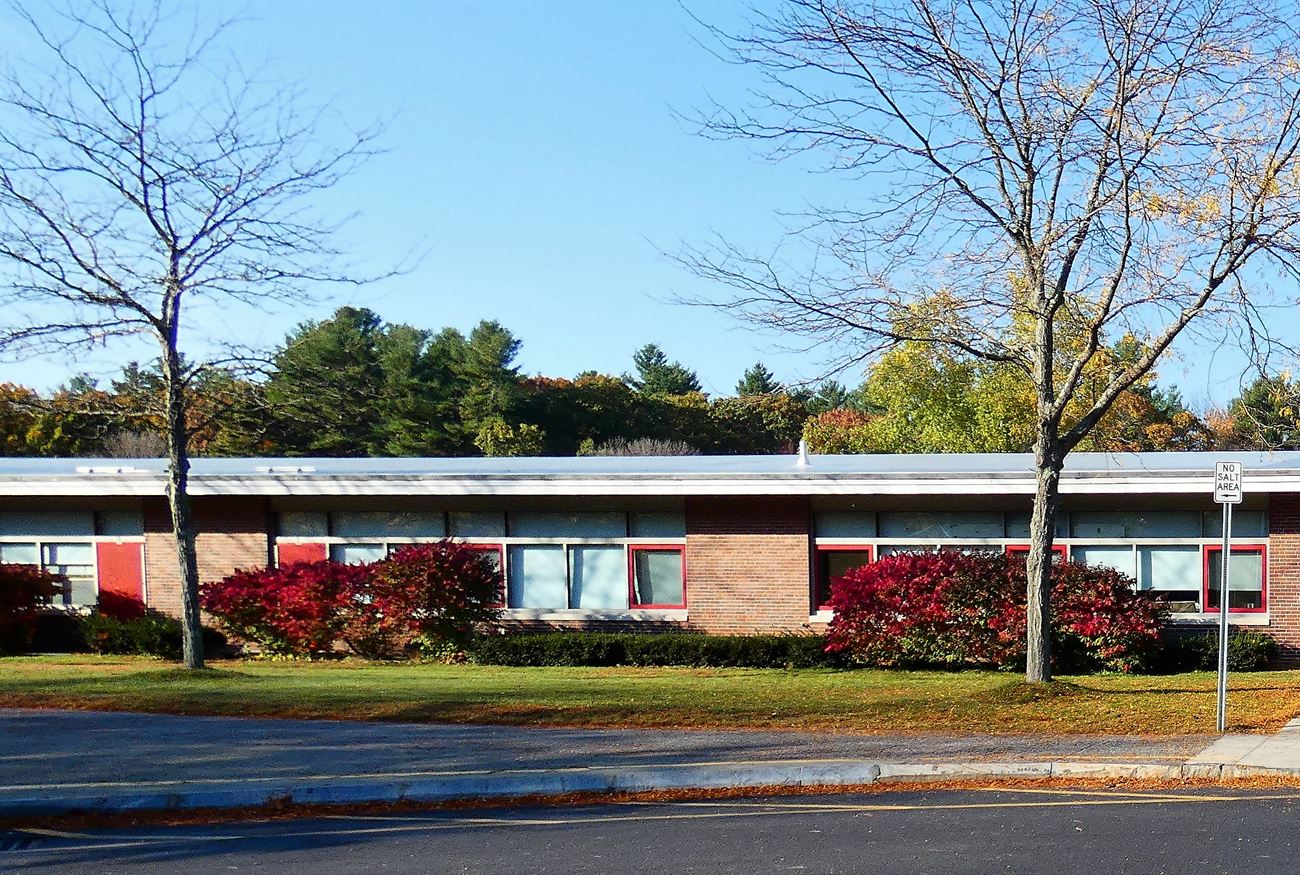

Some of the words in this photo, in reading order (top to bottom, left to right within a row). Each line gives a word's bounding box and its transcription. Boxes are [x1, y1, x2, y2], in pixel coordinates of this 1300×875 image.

[1222, 464, 1235, 472] NO
[1217, 473, 1239, 481] SALT
[1217, 482, 1239, 491] AREA
